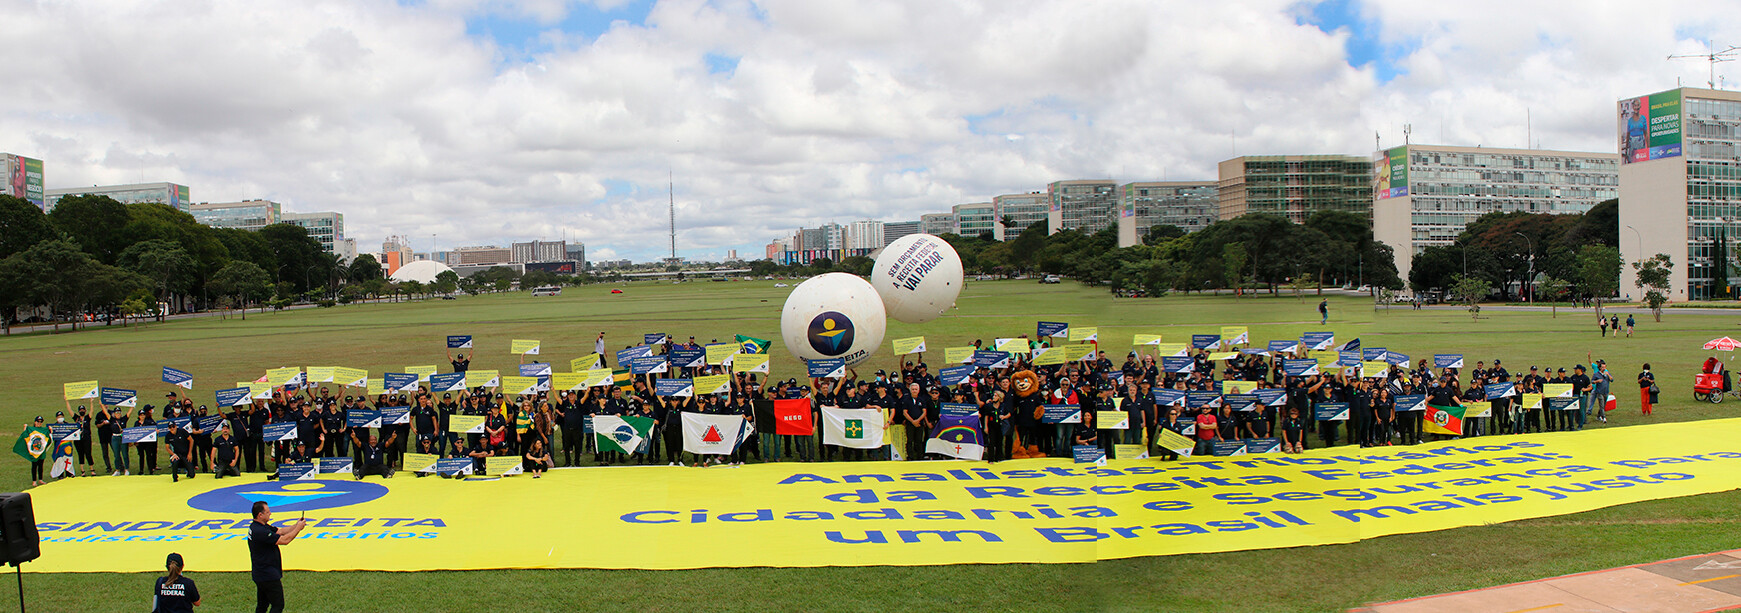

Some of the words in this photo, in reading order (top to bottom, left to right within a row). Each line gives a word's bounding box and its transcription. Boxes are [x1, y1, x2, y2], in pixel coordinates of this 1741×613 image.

[1651, 114, 1679, 124] DESPERTAR
[1663, 121, 1679, 129] NOVAS
[888, 262, 901, 277] SEM
[896, 258, 919, 282] RECEITA
[915, 241, 938, 260] FEDERAL
[903, 273, 921, 291] VAI
[915, 251, 943, 277] PARAR
[779, 441, 1546, 484] Analistas-Tributários
[824, 490, 937, 503] da
[965, 474, 1291, 498] Receita
[1303, 452, 1573, 480] Federal:
[620, 504, 1118, 523] Cidadania
[1144, 501, 1193, 511] e
[1213, 465, 1604, 504] Segurança
[1608, 452, 1741, 469] para
[825, 530, 1003, 543] um
[1034, 510, 1310, 542] Brasil
[1332, 492, 1523, 522] mais
[1515, 472, 1695, 500] justo
[36, 518, 447, 532] SINDIRECEITA
